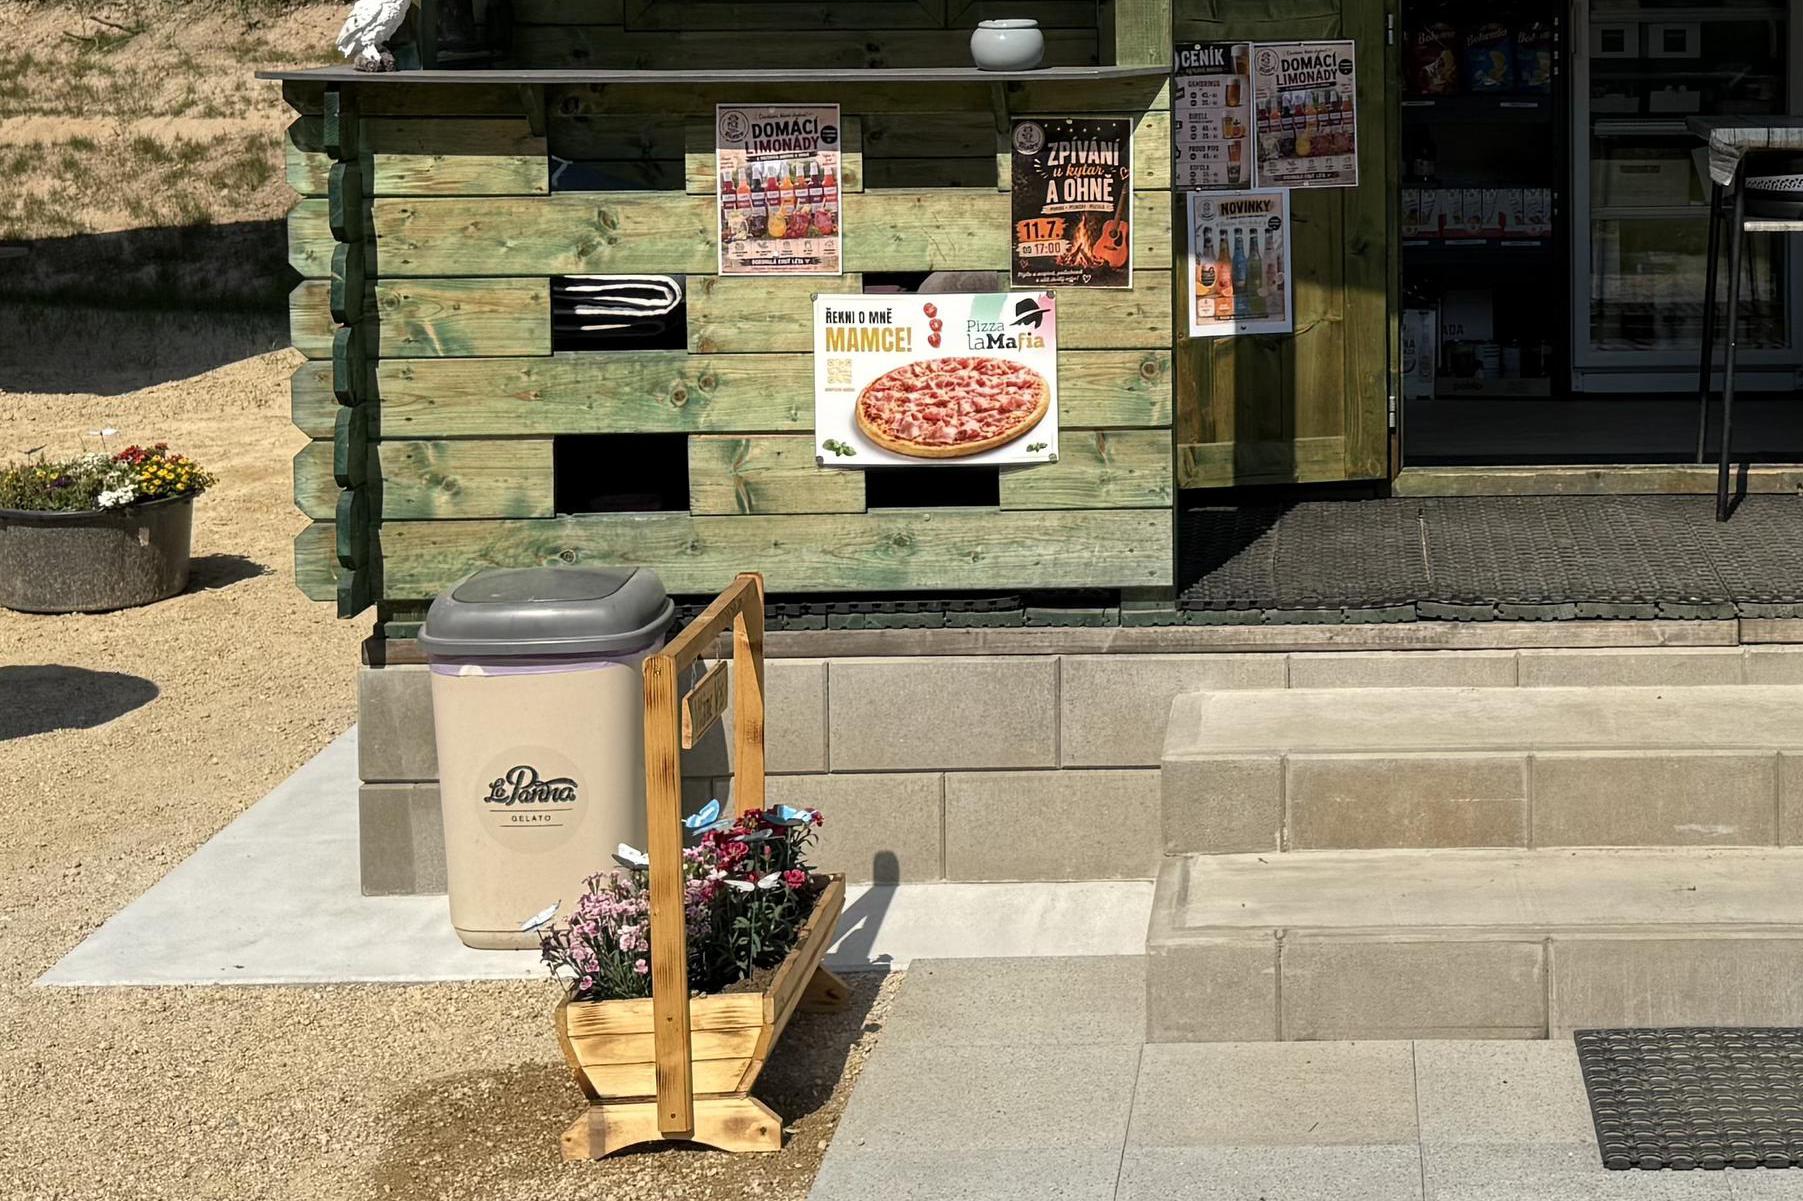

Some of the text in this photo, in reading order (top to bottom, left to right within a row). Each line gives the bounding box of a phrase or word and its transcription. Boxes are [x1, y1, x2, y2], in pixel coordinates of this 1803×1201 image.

[1181, 45, 1225, 68] CENÍK
[1281, 51, 1337, 72] DOMÁCÍ
[1276, 67, 1338, 86] LIMONÁDY
[751, 115, 819, 139] DOMÁCÍ
[745, 133, 820, 155] LIMONÁDY
[1047, 136, 1121, 167] ZPÍVÁNÍ
[1053, 168, 1064, 177] u
[1046, 174, 1114, 203] A OHNĚ
[1220, 199, 1272, 216] NOVINKY
[1034, 241, 1061, 254] 17:00
[825, 307, 893, 324] ŘEKNI O MNĚ
[967, 319, 1005, 333] Pizza
[825, 327, 913, 353] MAMCE!
[504, 765, 579, 807] Panna
[511, 814, 552, 823] GELATO
